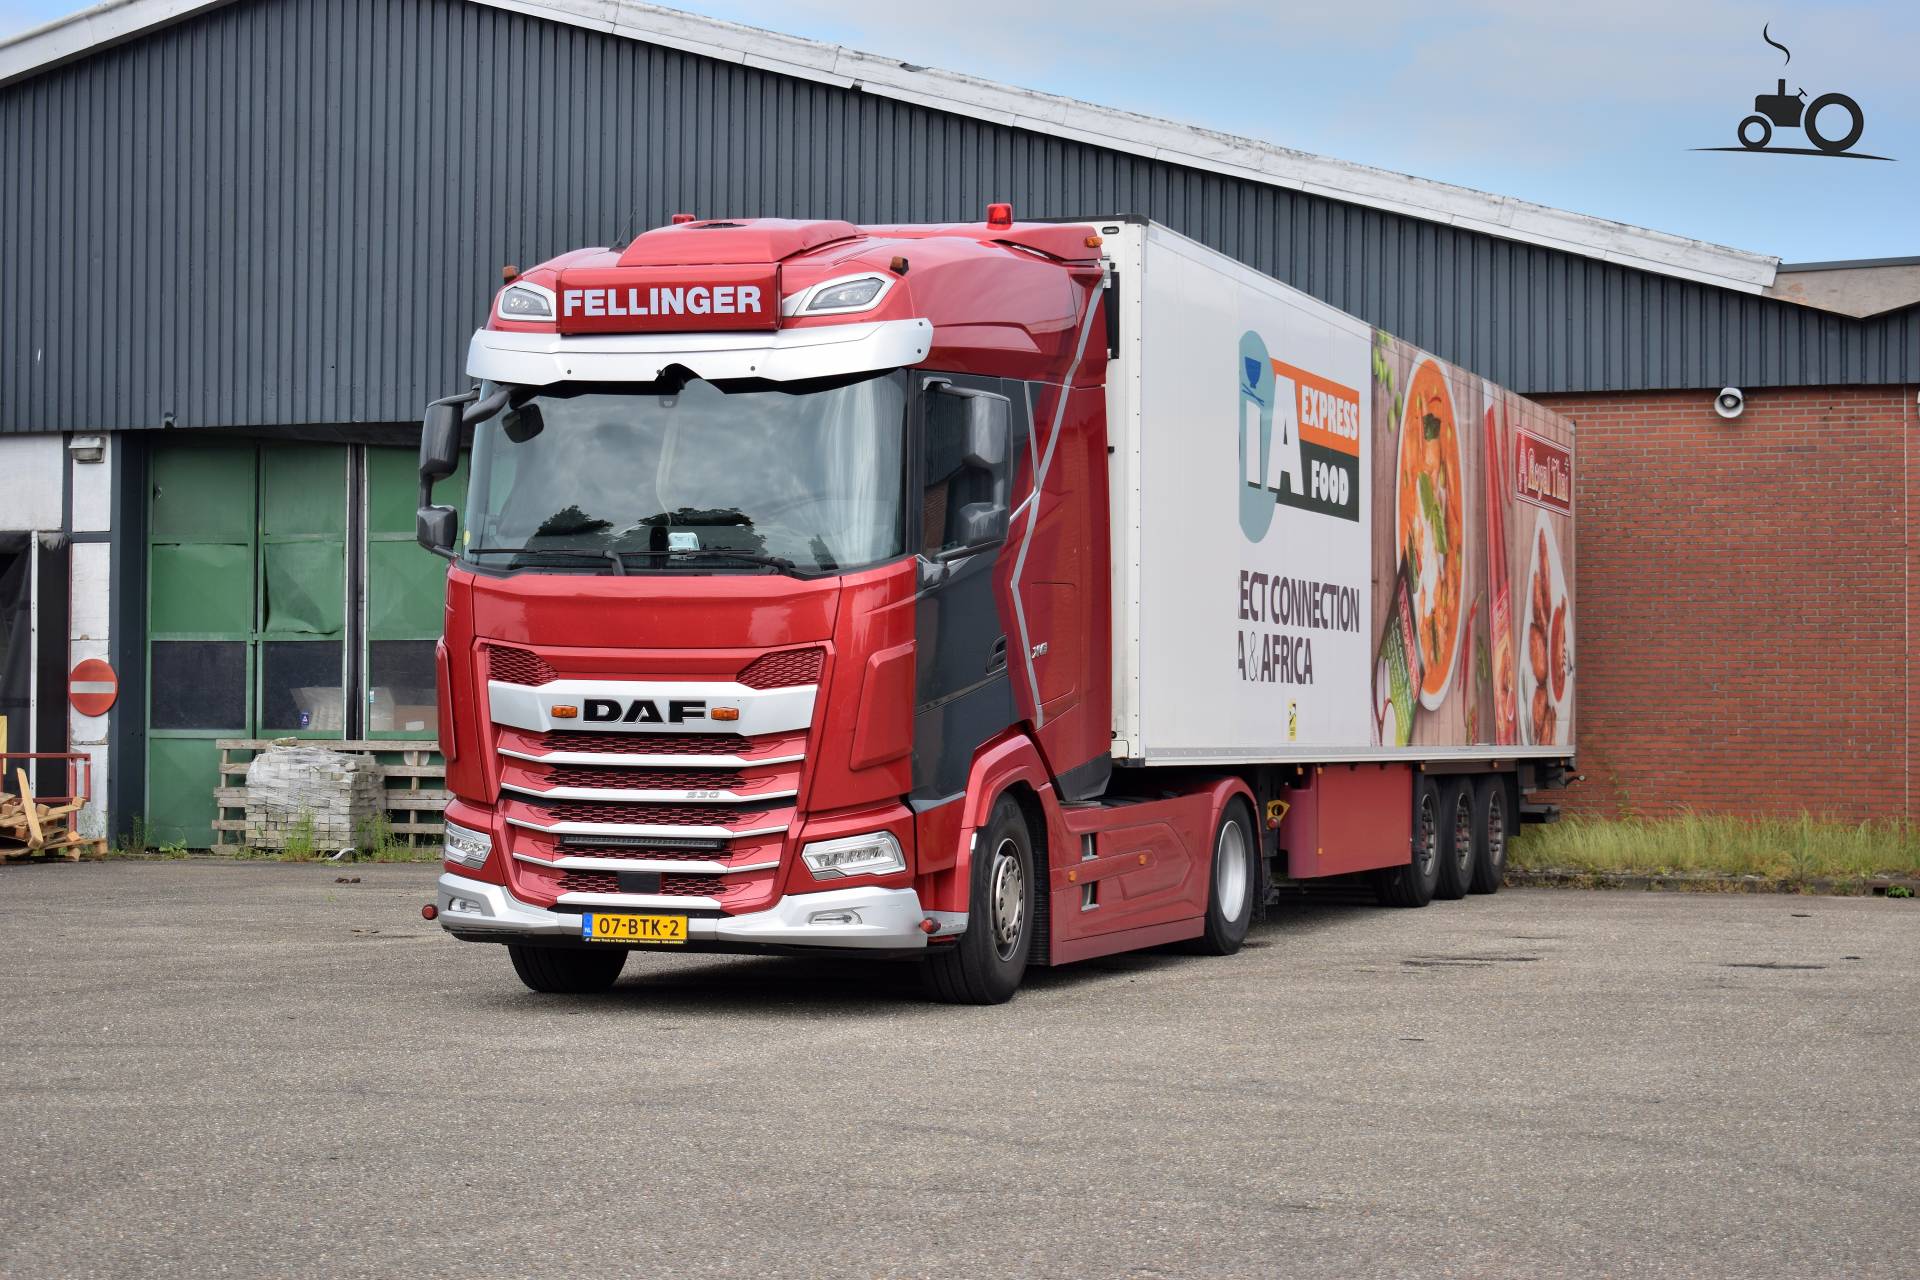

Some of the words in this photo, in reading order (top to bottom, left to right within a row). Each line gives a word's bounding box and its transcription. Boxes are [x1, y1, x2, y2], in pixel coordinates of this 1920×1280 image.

[563, 285, 762, 317] FELLINGER
[1301, 384, 1358, 441] EXPRESS
[1311, 459, 1349, 506] FOOD
[1270, 575, 1360, 633] CONNECTION
[1260, 633, 1313, 685] AFRICA
[583, 699, 706, 724] DAF
[599, 917, 680, 936] 07-BTK-2
